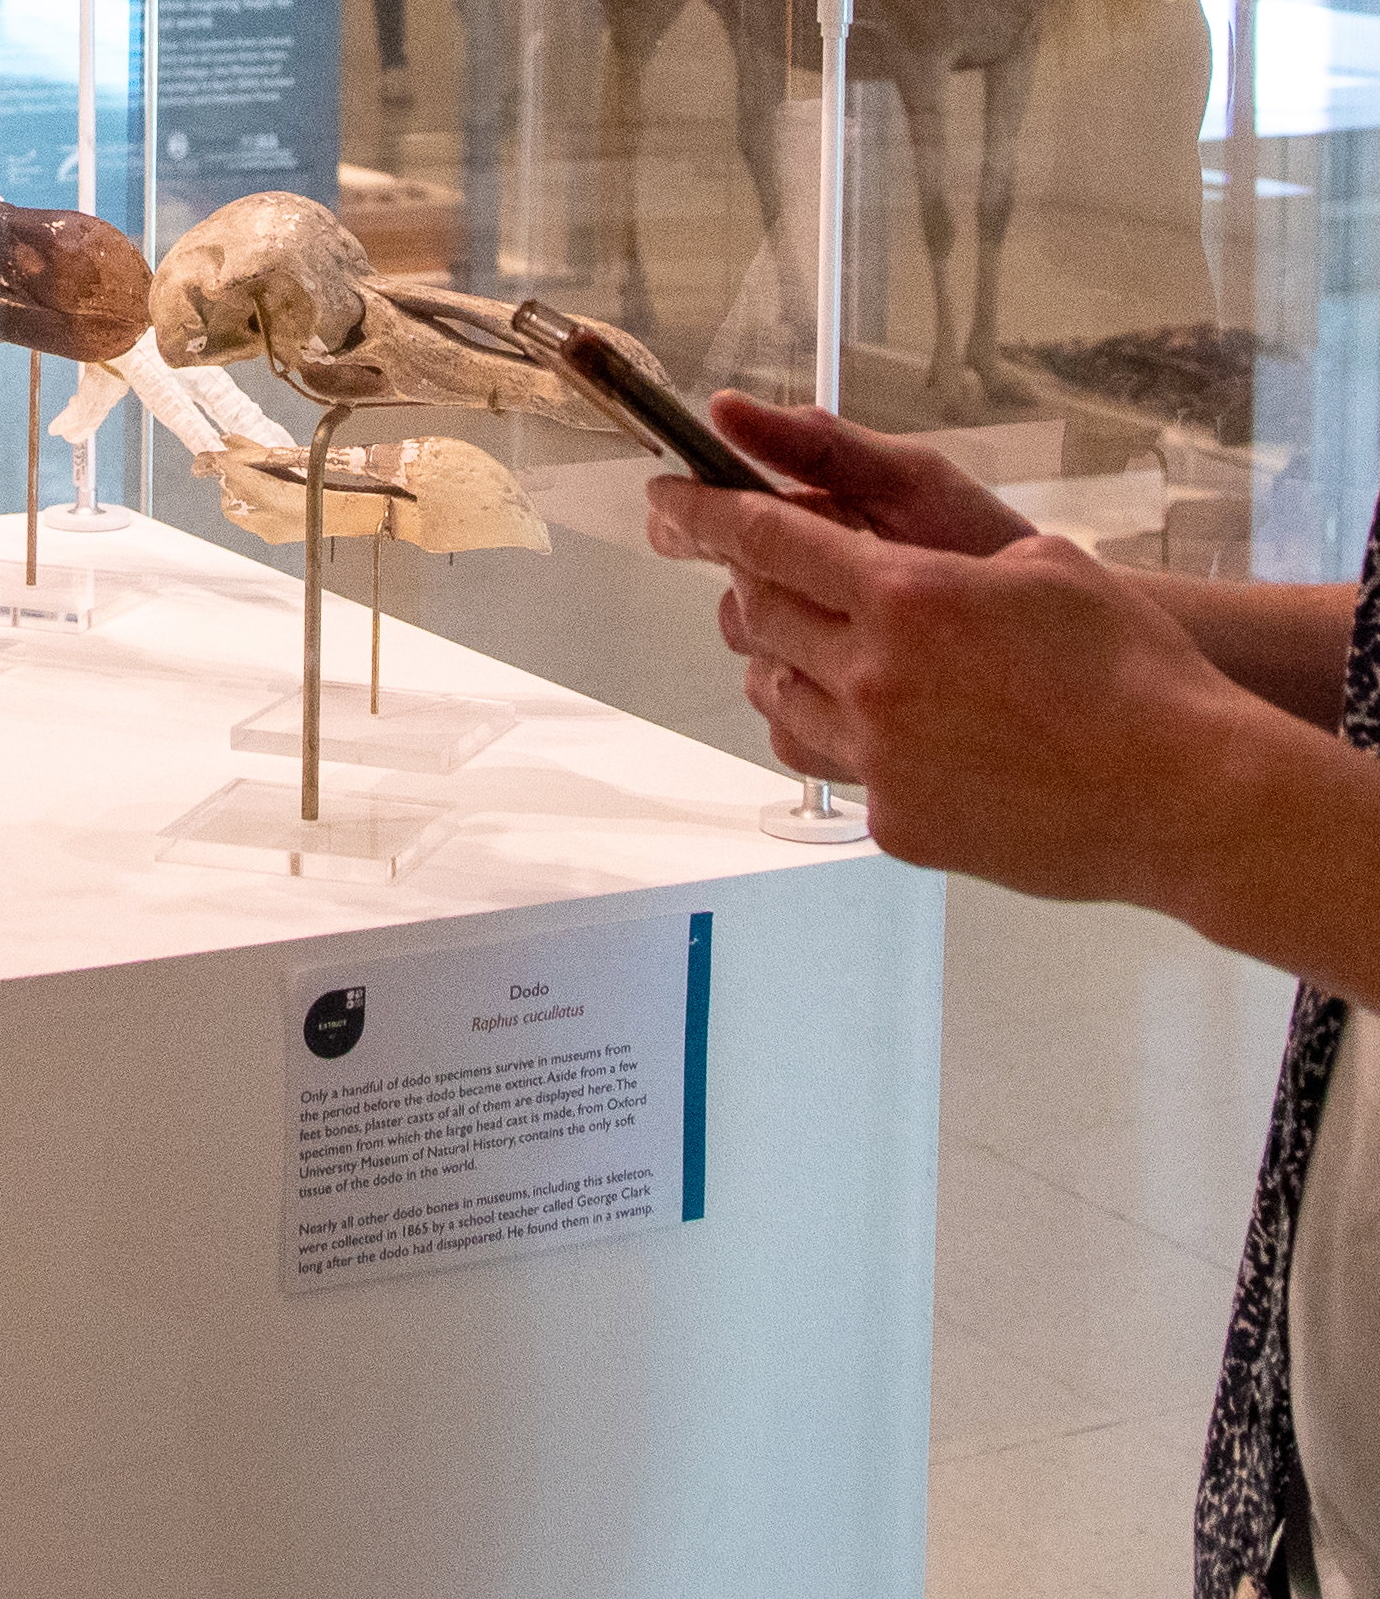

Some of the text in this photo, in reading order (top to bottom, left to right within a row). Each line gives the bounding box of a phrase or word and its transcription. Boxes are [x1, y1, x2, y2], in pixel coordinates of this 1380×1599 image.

[472, 1004, 585, 1033] Raphus cucullatus
[510, 983, 549, 1000] Dodo
[299, 1044, 631, 1104] Only a handful of dodo specimens survive in museums from
[299, 1129, 321, 1142] feet
[365, 1117, 403, 1134] plaster
[407, 1113, 434, 1125] casts
[437, 1107, 450, 1119] of
[451, 1105, 465, 1117] all
[467, 1101, 480, 1114] of
[483, 1100, 511, 1112] them
[515, 1097, 532, 1108] are
[535, 1086, 584, 1104] displayed
[615, 1078, 637, 1090] The
[299, 1144, 352, 1163] specimen
[355, 1139, 384, 1151] from
[387, 1131, 421, 1146] which
[423, 1129, 443, 1141] the
[445, 1124, 473, 1138] large
[475, 1117, 502, 1131] head
[505, 1115, 528, 1127] cast
[531, 1113, 540, 1123] is
[577, 1104, 604, 1114] from
[607, 1094, 647, 1110] Oxford
[299, 1220, 337, 1236] Nearly
[341, 1216, 354, 1229] all
[357, 1213, 389, 1227] other
[391, 1206, 423, 1221] dodo
[425, 1202, 459, 1215] bones
[463, 1198, 473, 1208] in
[533, 1180, 580, 1196] including
[583, 1176, 603, 1187] this
[299, 1185, 650, 1255] were collected in 1865 by a school teacher called George Clark
[297, 1261, 323, 1275] long
[325, 1256, 353, 1269] after
[355, 1252, 376, 1264] the
[379, 1246, 409, 1261] dodo
[413, 1241, 433, 1254] had
[507, 1226, 524, 1238] He
[527, 1219, 558, 1235] found
[561, 1216, 589, 1229] them
[593, 1214, 603, 1223] in
[605, 1213, 612, 1221] a
